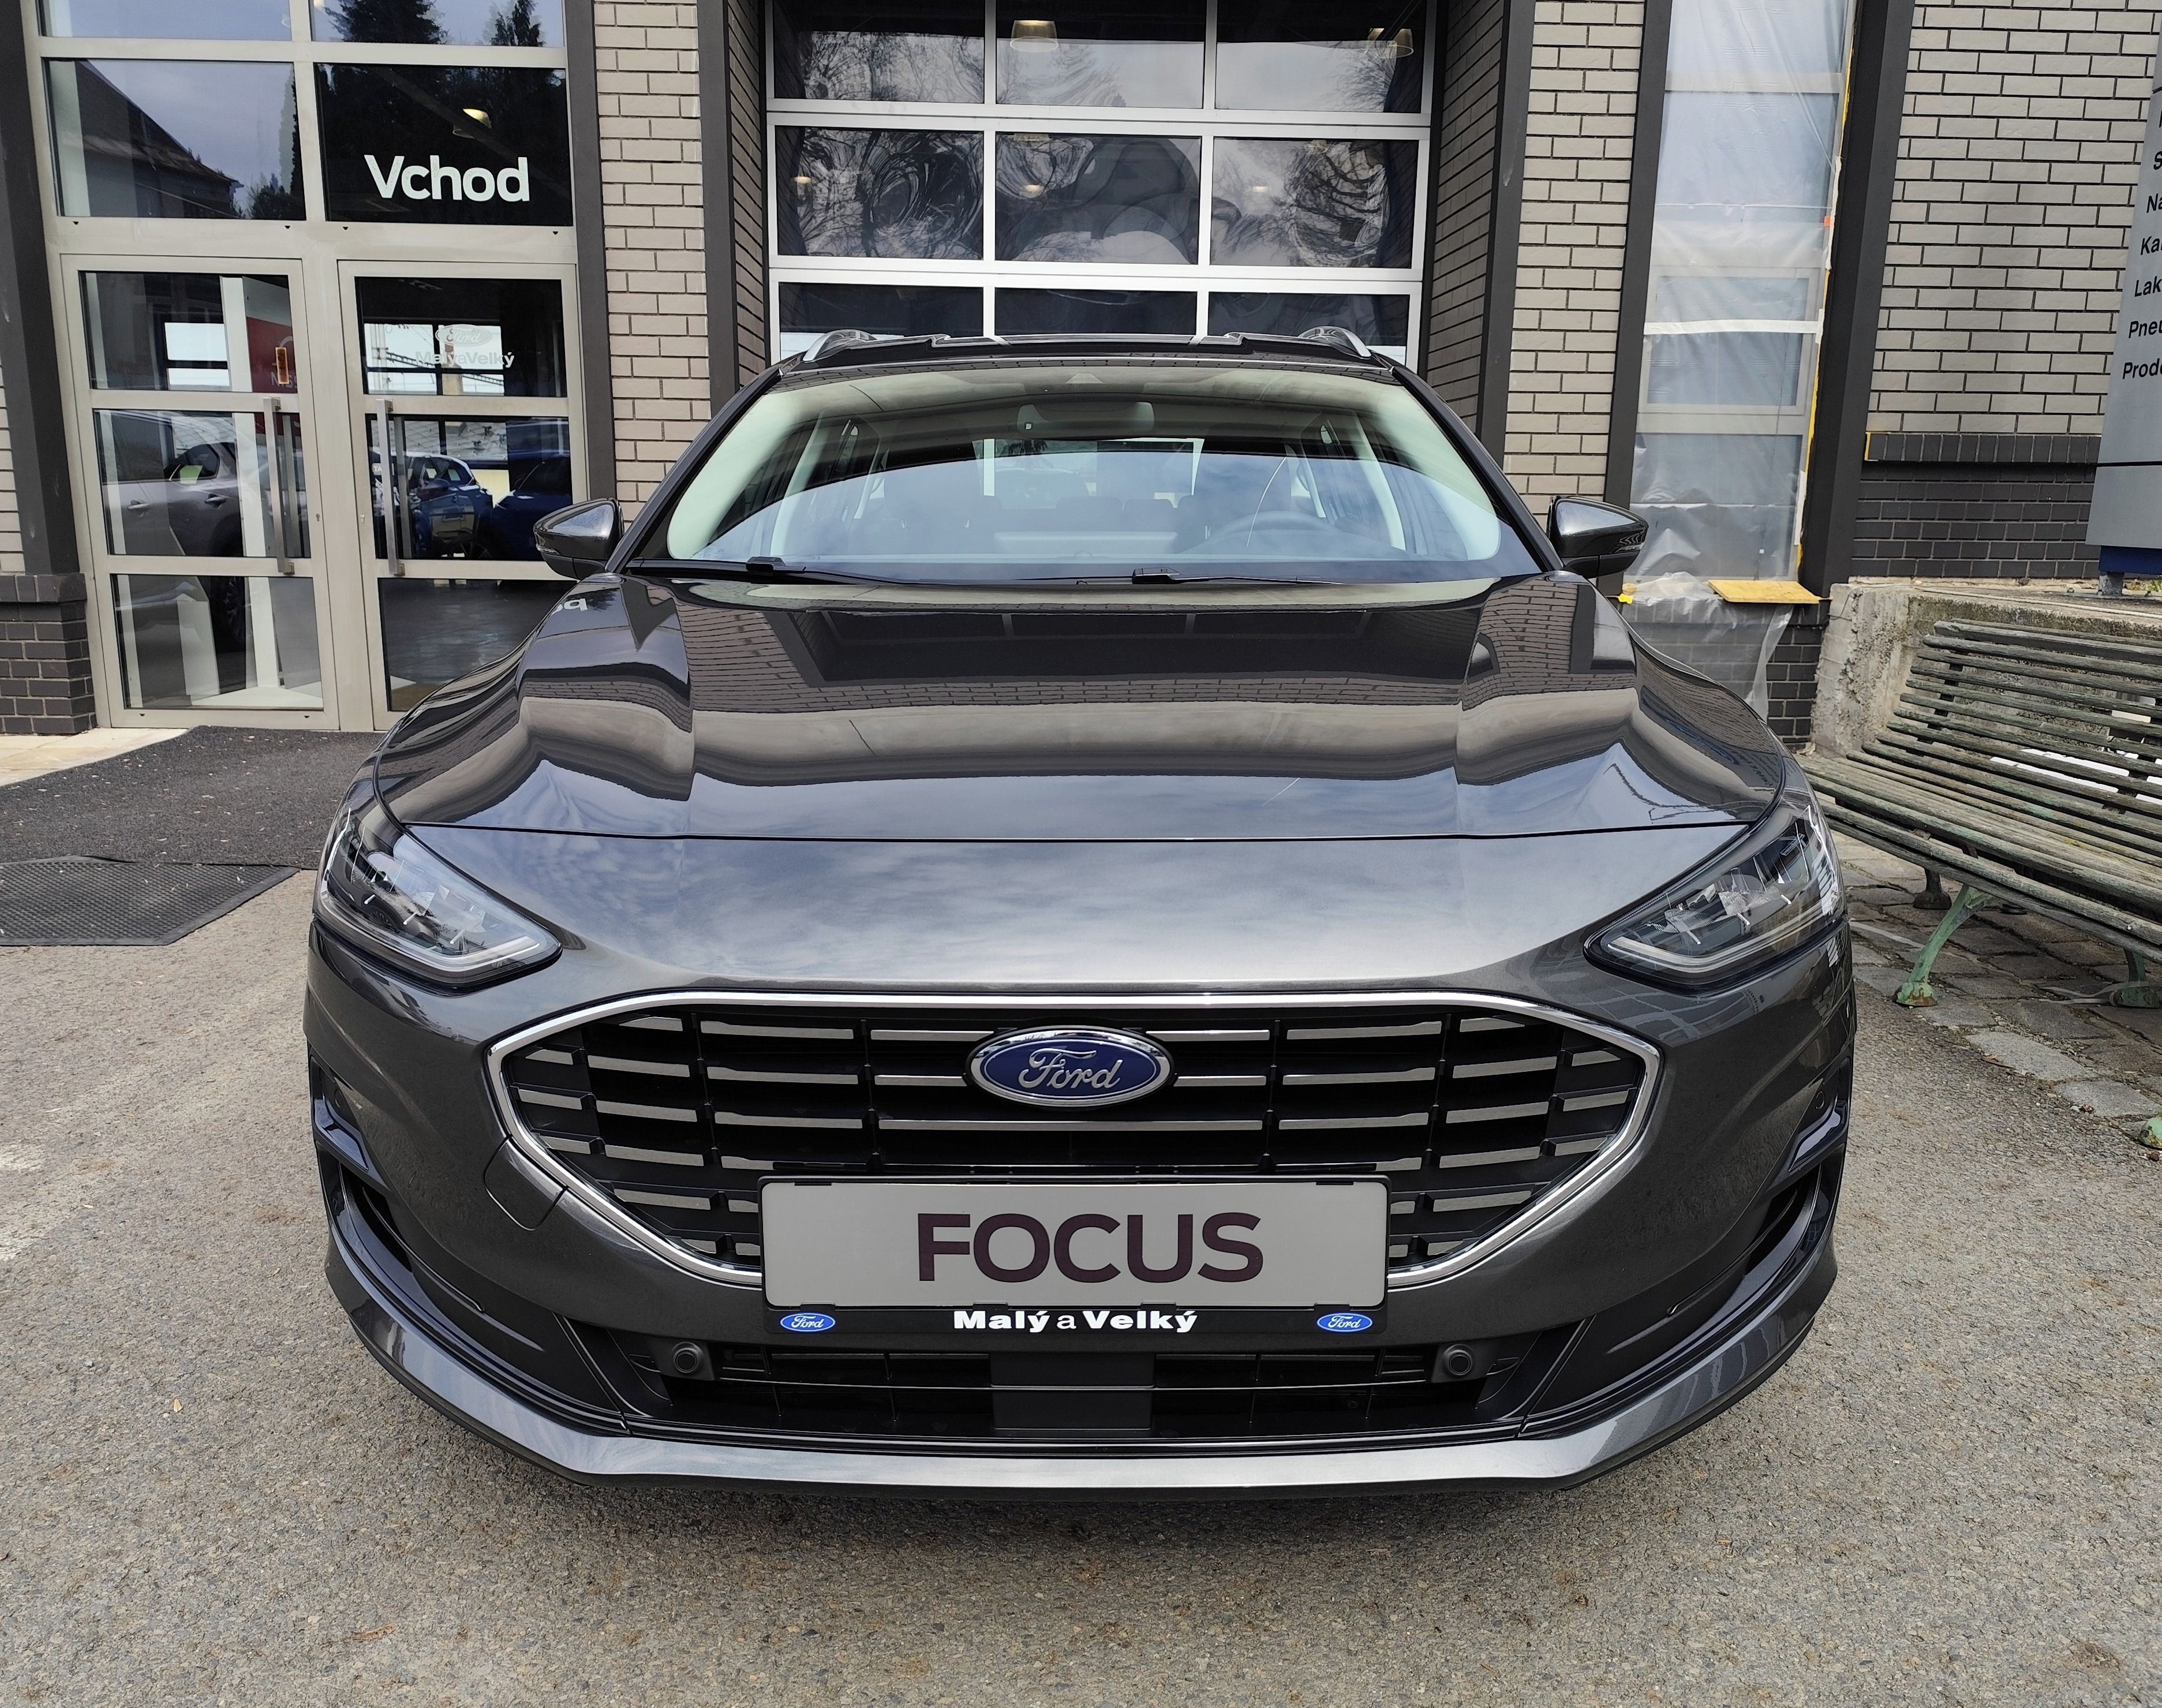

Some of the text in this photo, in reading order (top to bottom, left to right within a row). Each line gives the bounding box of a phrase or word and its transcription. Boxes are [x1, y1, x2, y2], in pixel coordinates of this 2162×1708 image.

[364, 154, 530, 202] Vchod
[2140, 236, 2162, 256] Ka
[446, 326, 481, 342] Ford
[2122, 358, 2162, 380] Prod
[1018, 1048, 1123, 1089] Ford
[918, 1212, 1264, 1283] FOCUS
[791, 1315, 825, 1328] Ford
[953, 1310, 1199, 1333] Malý a Velký
[1327, 1315, 1362, 1328] Ford
